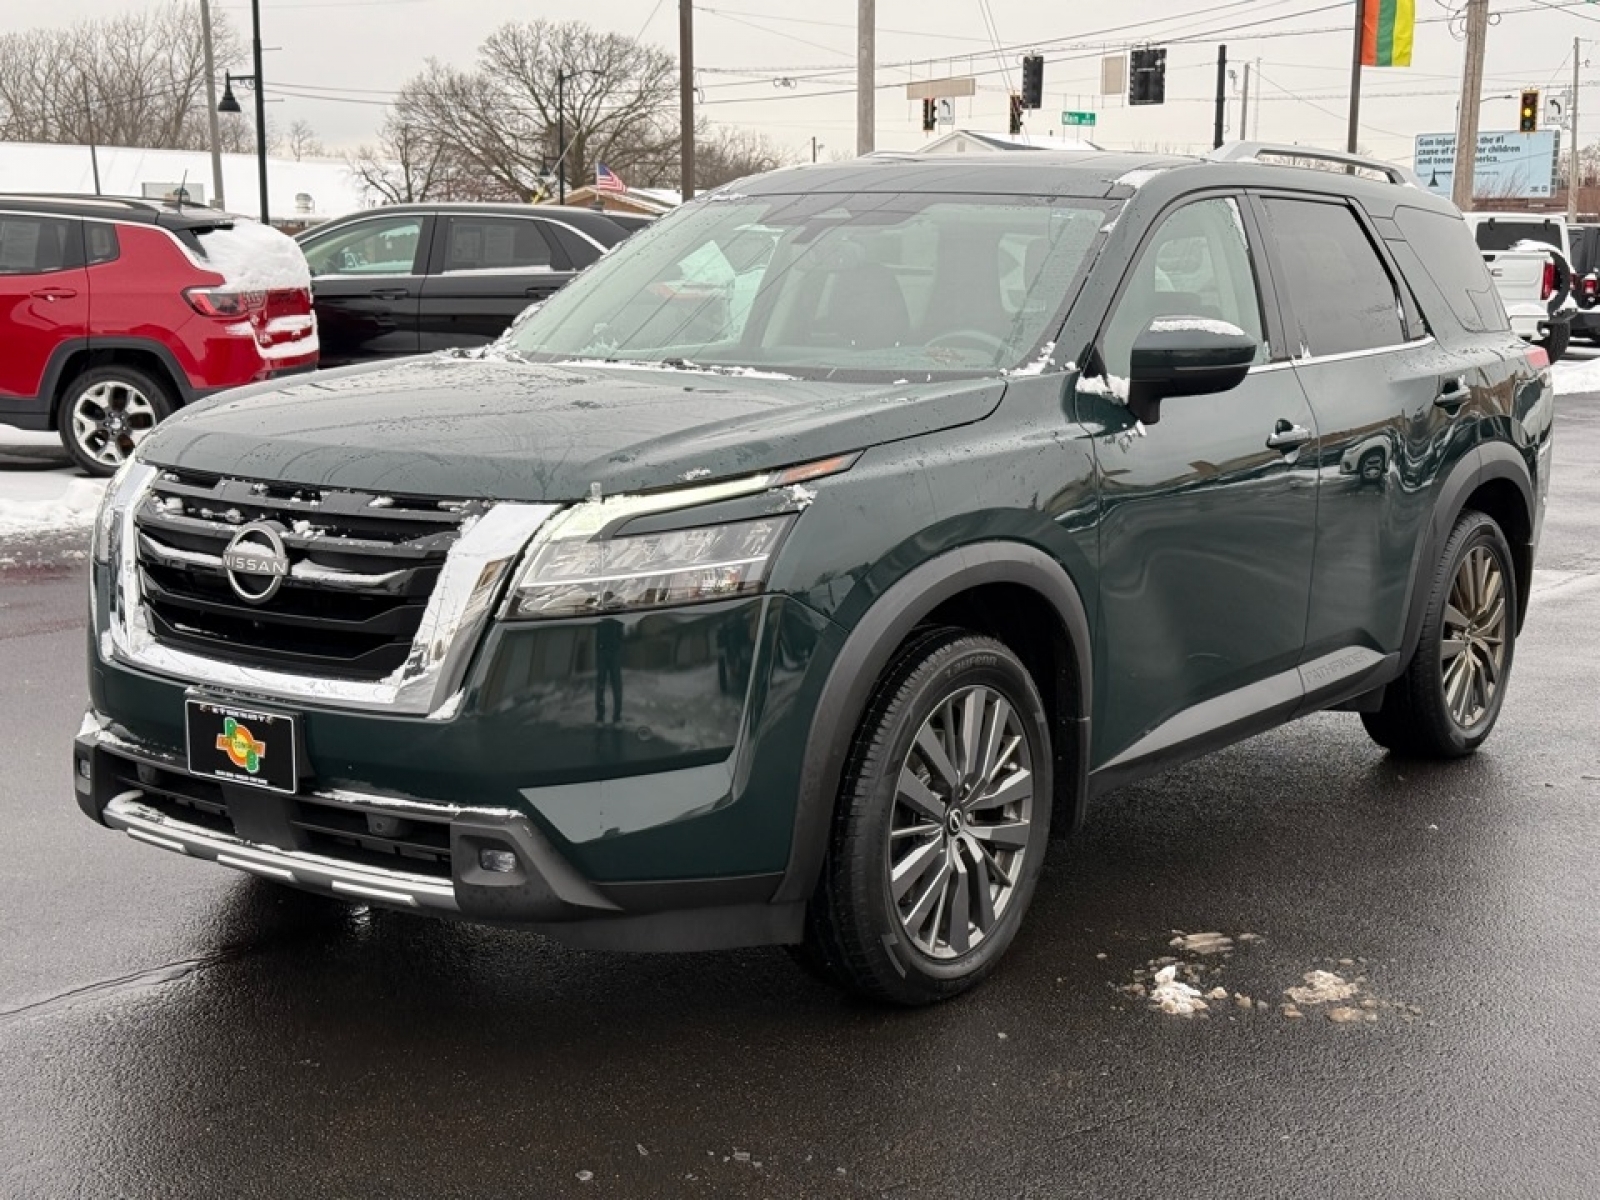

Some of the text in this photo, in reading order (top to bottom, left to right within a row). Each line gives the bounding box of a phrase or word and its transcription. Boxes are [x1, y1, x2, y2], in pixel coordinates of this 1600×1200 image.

[1418, 138, 1434, 146] Gun
[1495, 135, 1504, 144] #1
[1418, 148, 1439, 156] cause
[1441, 147, 1450, 155] of
[1488, 145, 1520, 153] children
[1418, 156, 1432, 165] and
[223, 554, 286, 573] NISSAN
